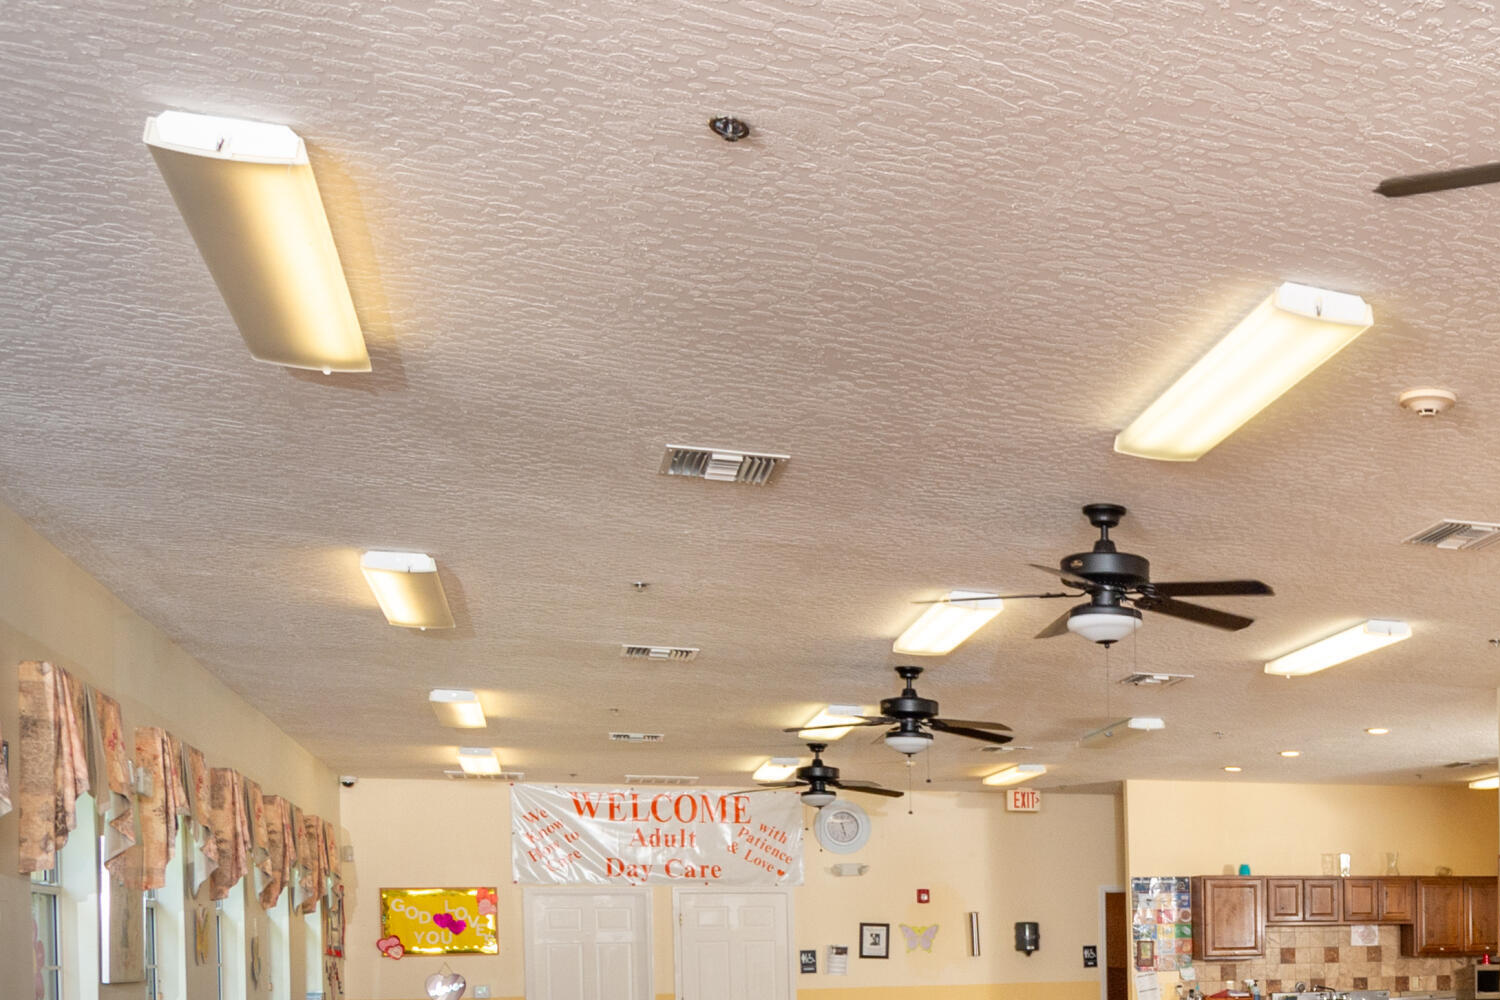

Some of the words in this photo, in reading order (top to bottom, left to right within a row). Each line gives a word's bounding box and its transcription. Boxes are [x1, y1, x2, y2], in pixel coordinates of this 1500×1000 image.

[569, 791, 752, 824] WELCOME
[1013, 791, 1036, 809] EXIT
[522, 808, 548, 823] We
[564, 831, 579, 844] to
[630, 827, 697, 848] Adult
[760, 823, 787, 844] with
[737, 826, 793, 864] Patience
[606, 857, 653, 881] Day
[663, 858, 722, 878] Care
[744, 849, 774, 872] Love
[390, 898, 431, 924] GOD
[413, 931, 453, 945] YOU
